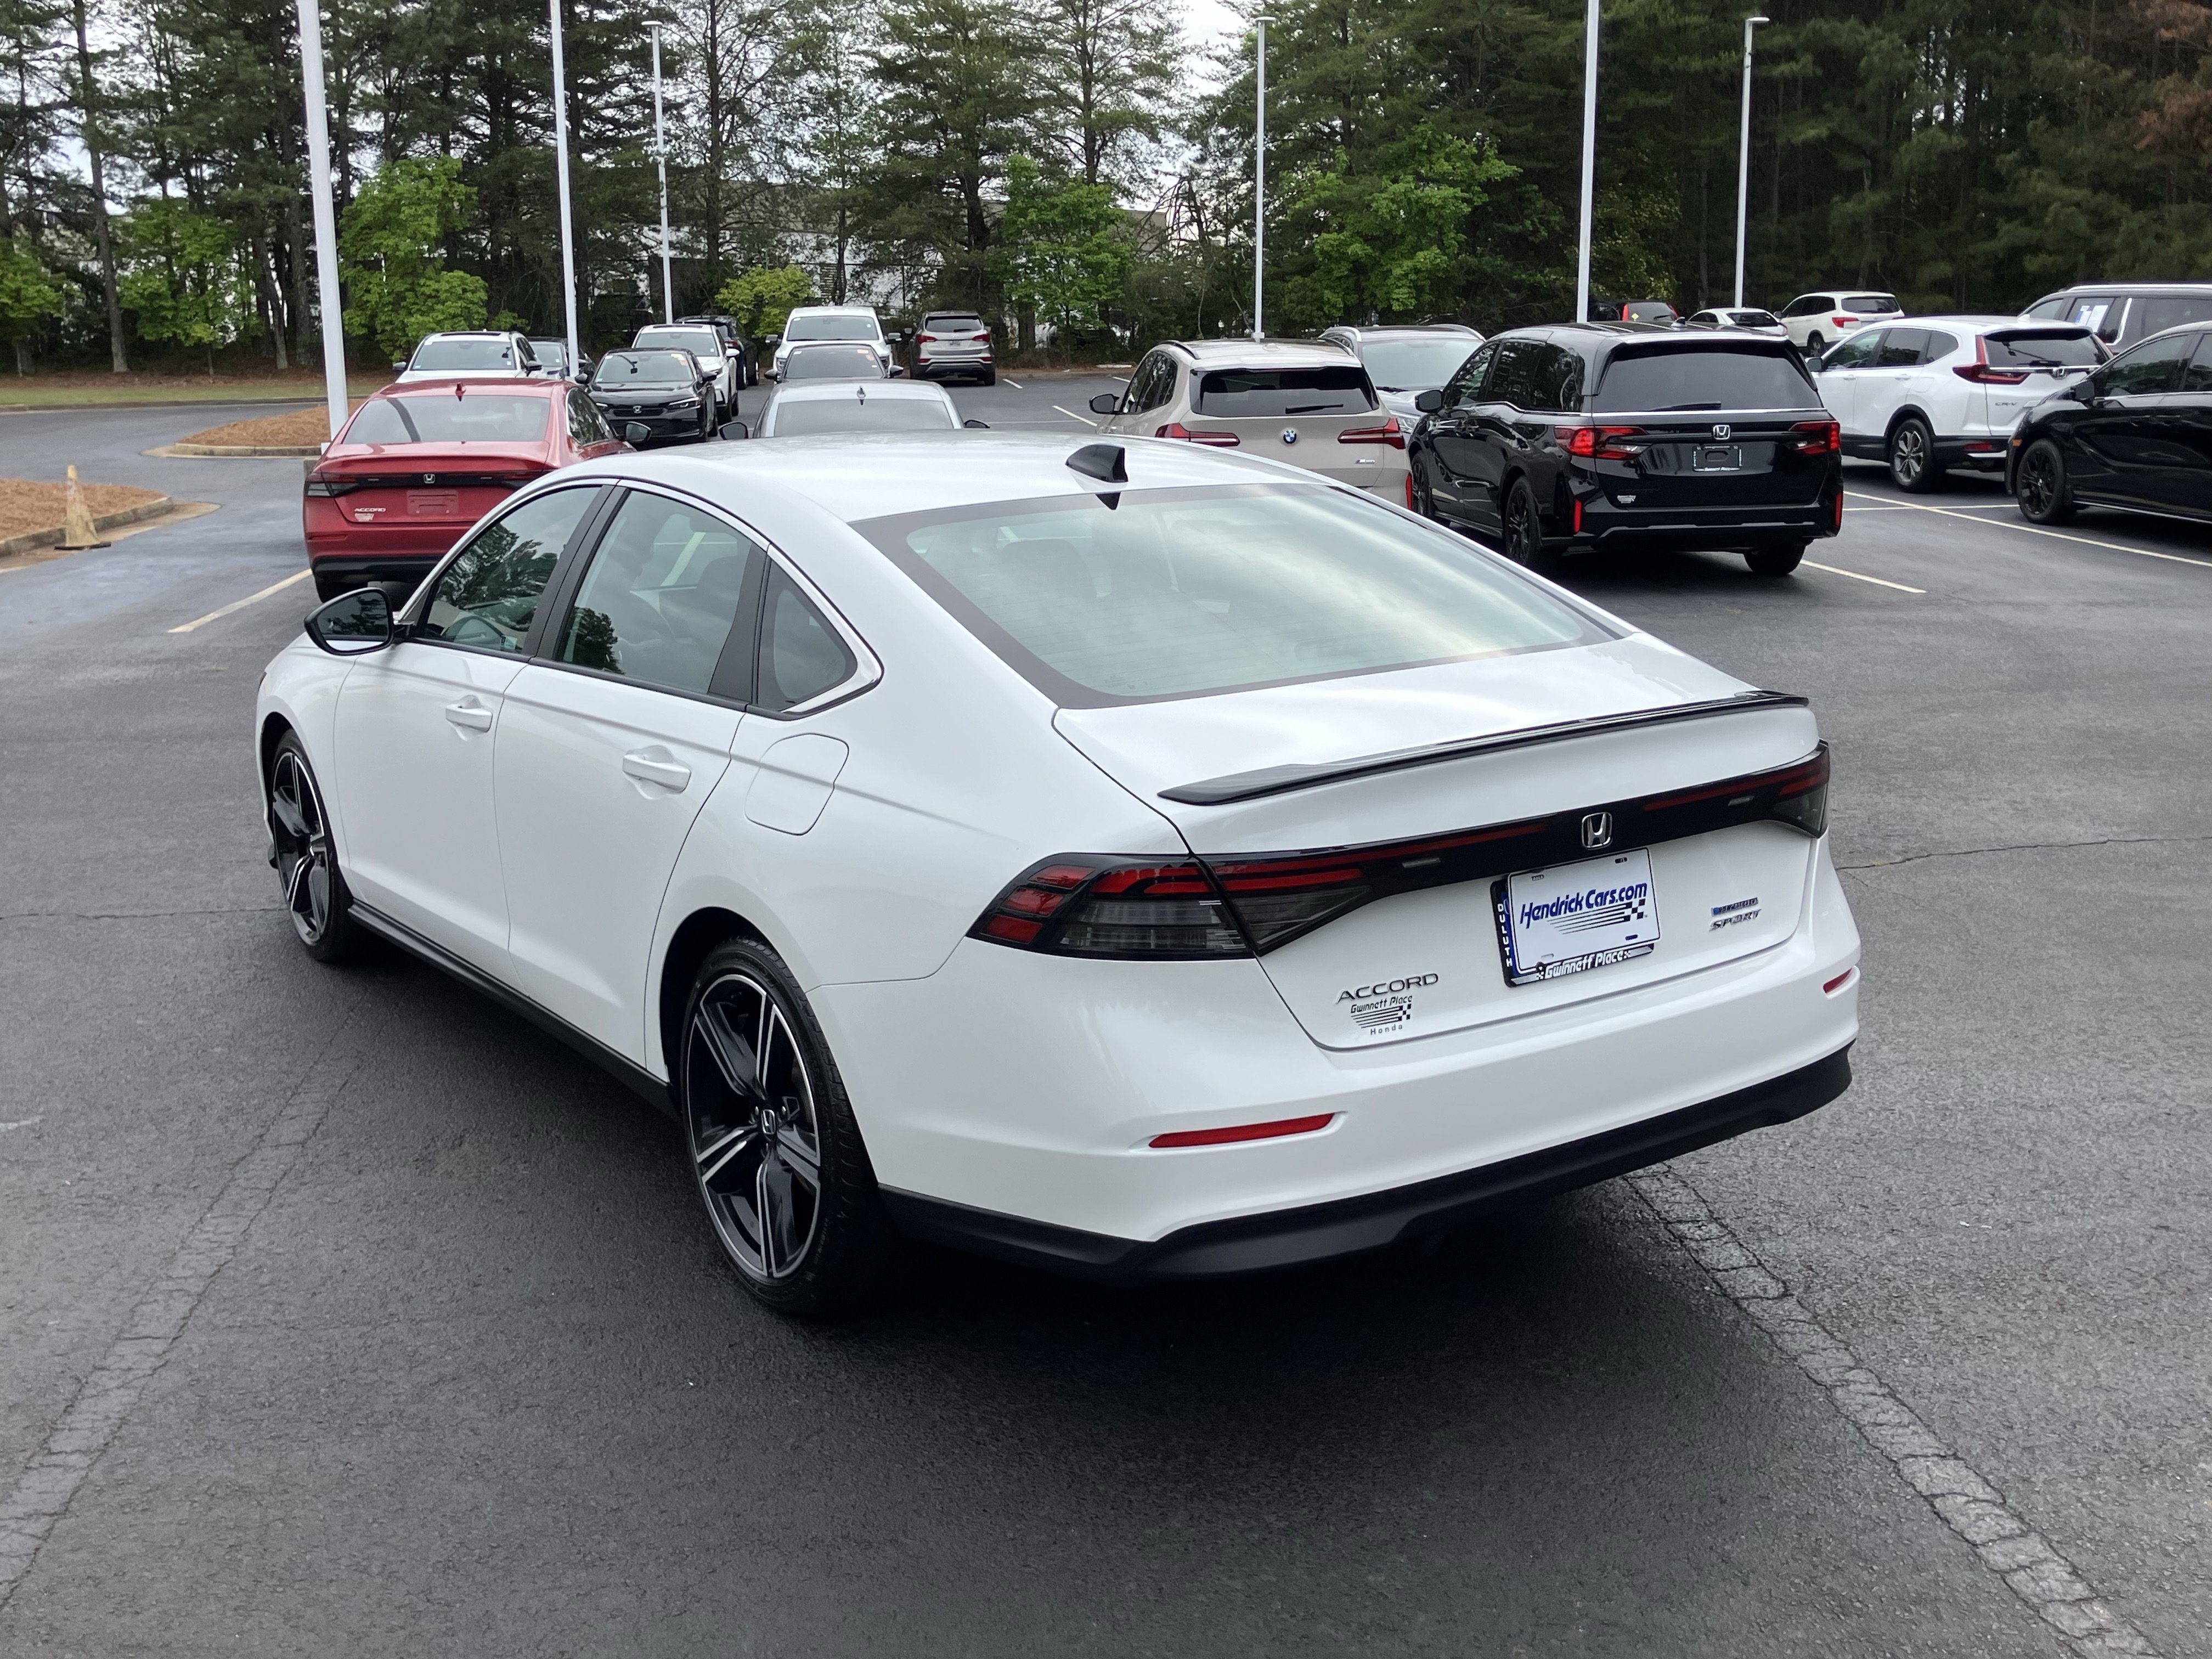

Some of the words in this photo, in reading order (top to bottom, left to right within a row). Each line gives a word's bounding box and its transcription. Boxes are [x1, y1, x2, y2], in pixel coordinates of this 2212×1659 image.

[1519, 892, 1584, 929] Hendrick
[1585, 882, 1647, 909] Cars.com
[1497, 903, 1513, 967] DULUTH
[1708, 909, 1762, 932] SPORT
[1544, 957, 1594, 979] Gwinnett
[1594, 950, 1624, 968] Place
[1335, 973, 1438, 1005] ACCORD
[1350, 998, 1388, 1014] Gwinnett
[1389, 995, 1413, 1007] Place
[1370, 1024, 1403, 1036] Honda
